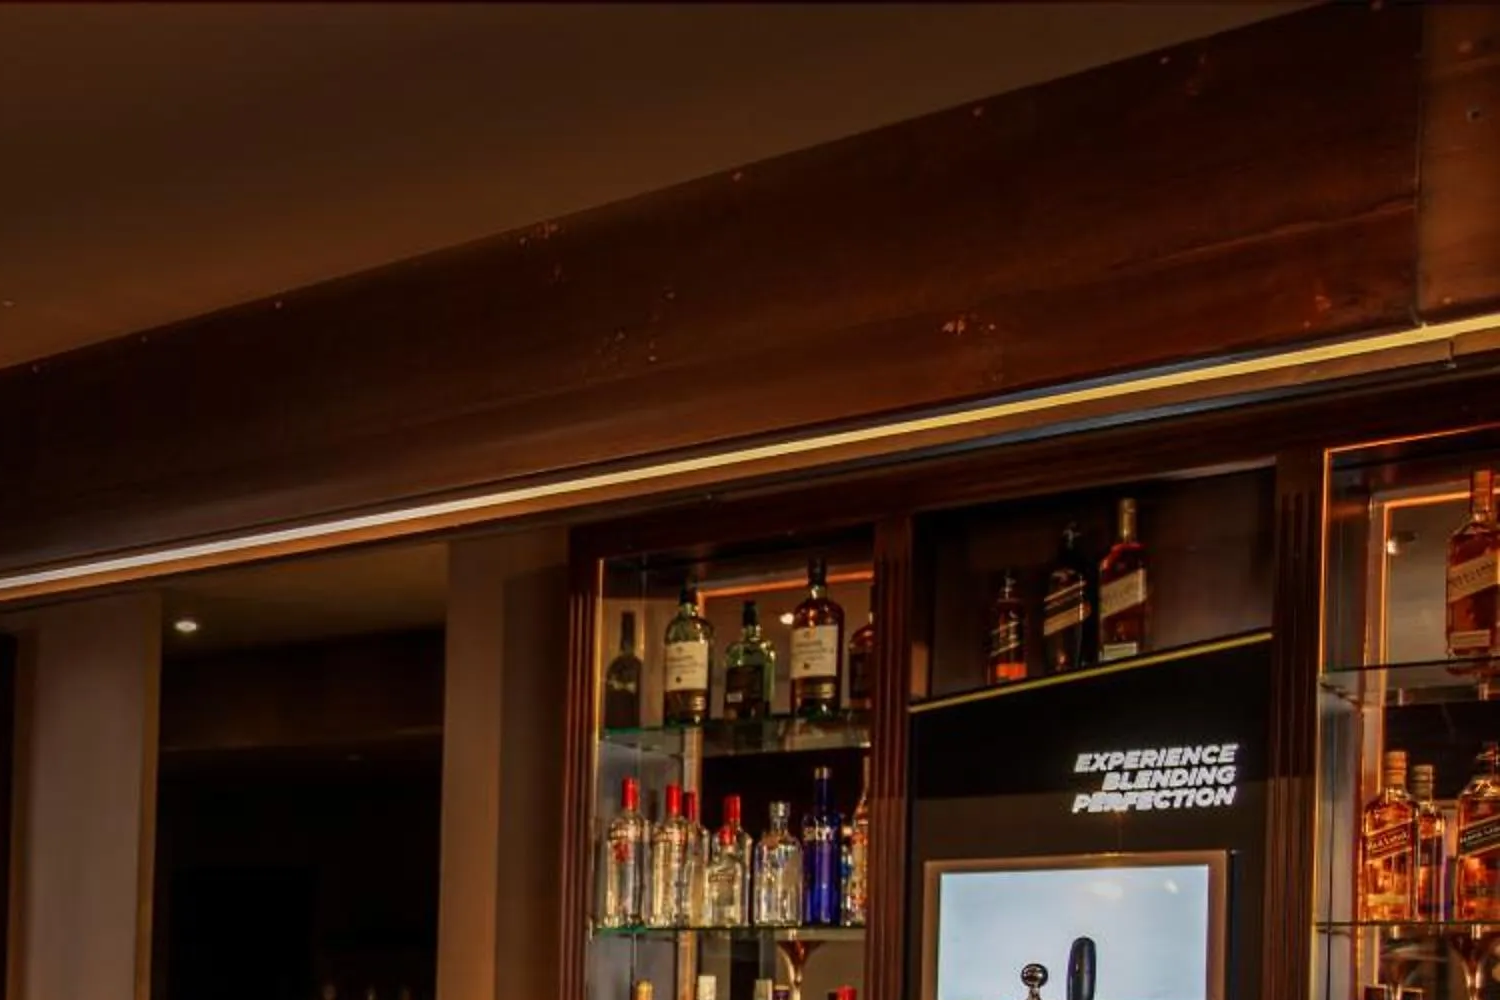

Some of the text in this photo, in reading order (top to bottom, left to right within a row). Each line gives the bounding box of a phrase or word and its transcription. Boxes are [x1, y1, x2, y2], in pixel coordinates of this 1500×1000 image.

[1074, 743, 1239, 773] EXPERIENCE
[1102, 765, 1236, 791] BLENDING
[1072, 786, 1236, 813] PERFECTION
